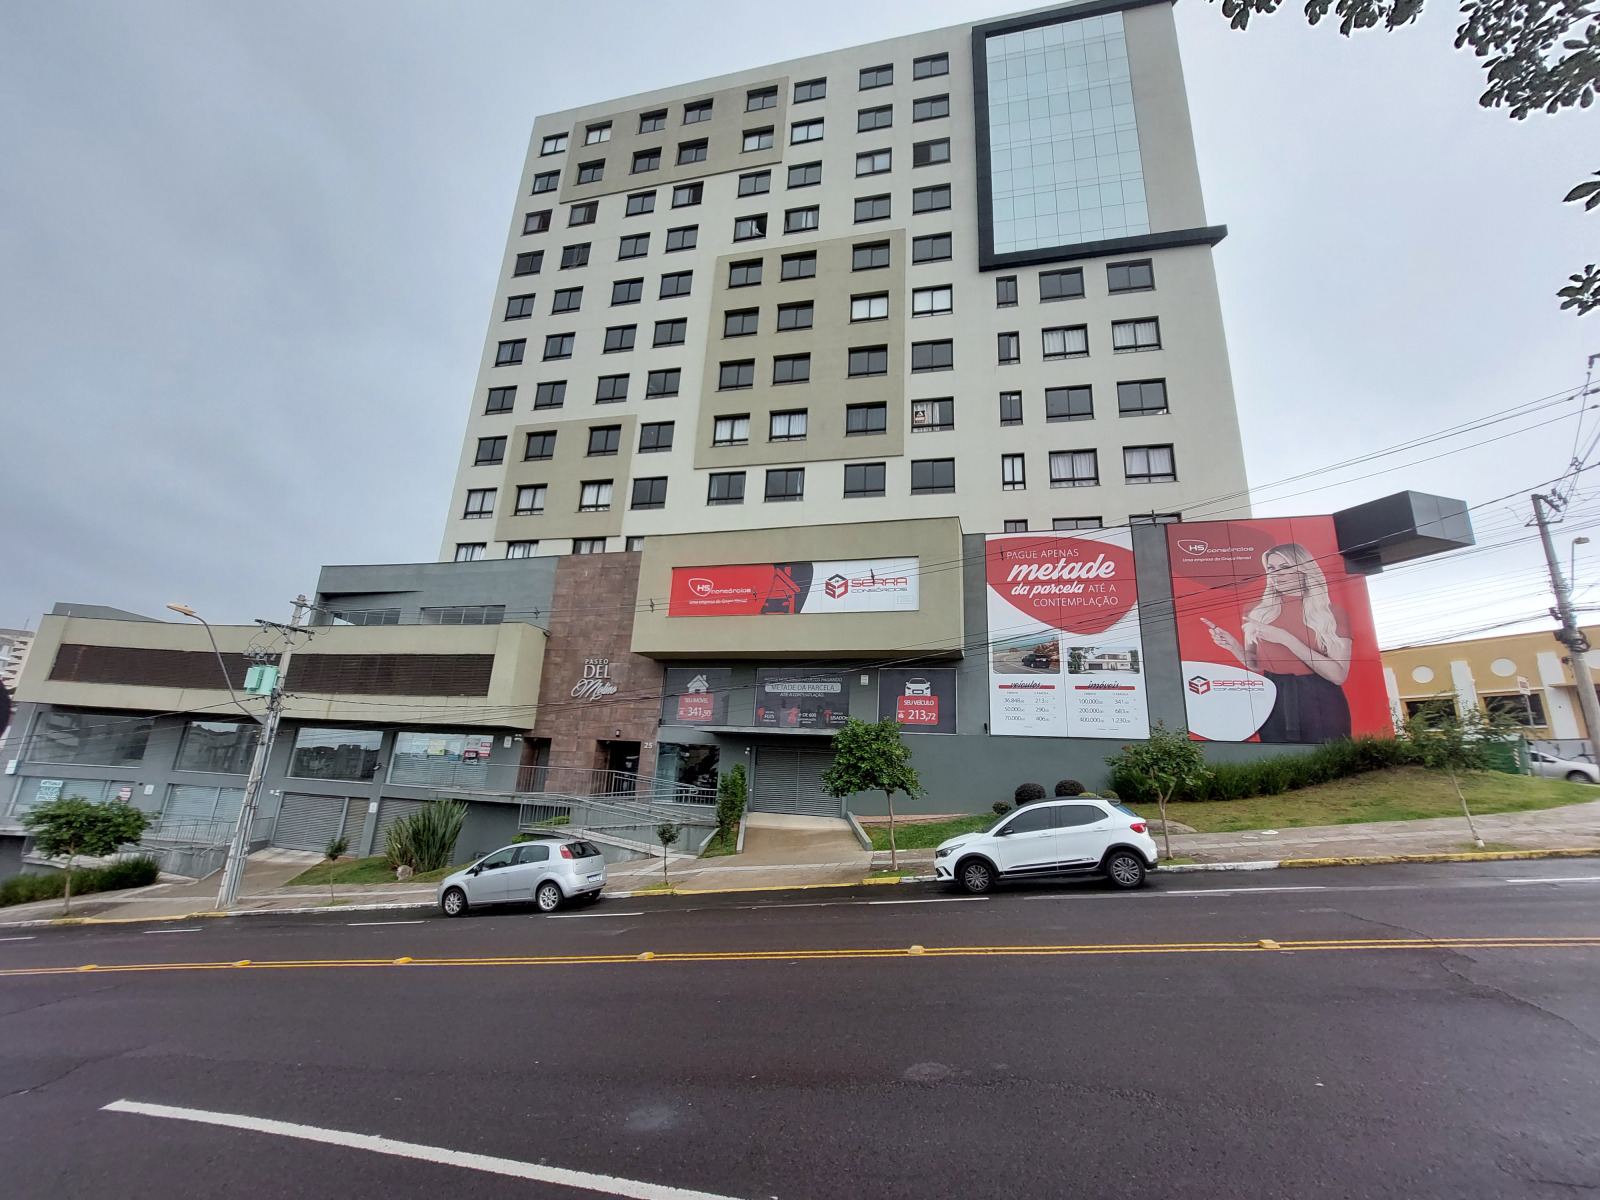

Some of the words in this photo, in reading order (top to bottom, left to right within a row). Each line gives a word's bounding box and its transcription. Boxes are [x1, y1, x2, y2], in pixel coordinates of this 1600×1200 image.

[1006, 550, 1037, 559] PAGUE
[1041, 548, 1079, 558] APENAS
[1006, 553, 1115, 581] metade
[851, 577, 908, 588] SERRA
[1011, 582, 1029, 595] da
[1029, 580, 1085, 598] parcela
[1088, 583, 1106, 592] ATÉ
[1109, 584, 1117, 592] A
[1033, 596, 1118, 607] CONTEMPLAÇÃO
[584, 664, 611, 679] DEL
[1087, 680, 1120, 689] imóveis
[688, 707, 712, 718] 341,50
[908, 709, 936, 721] 213,72
